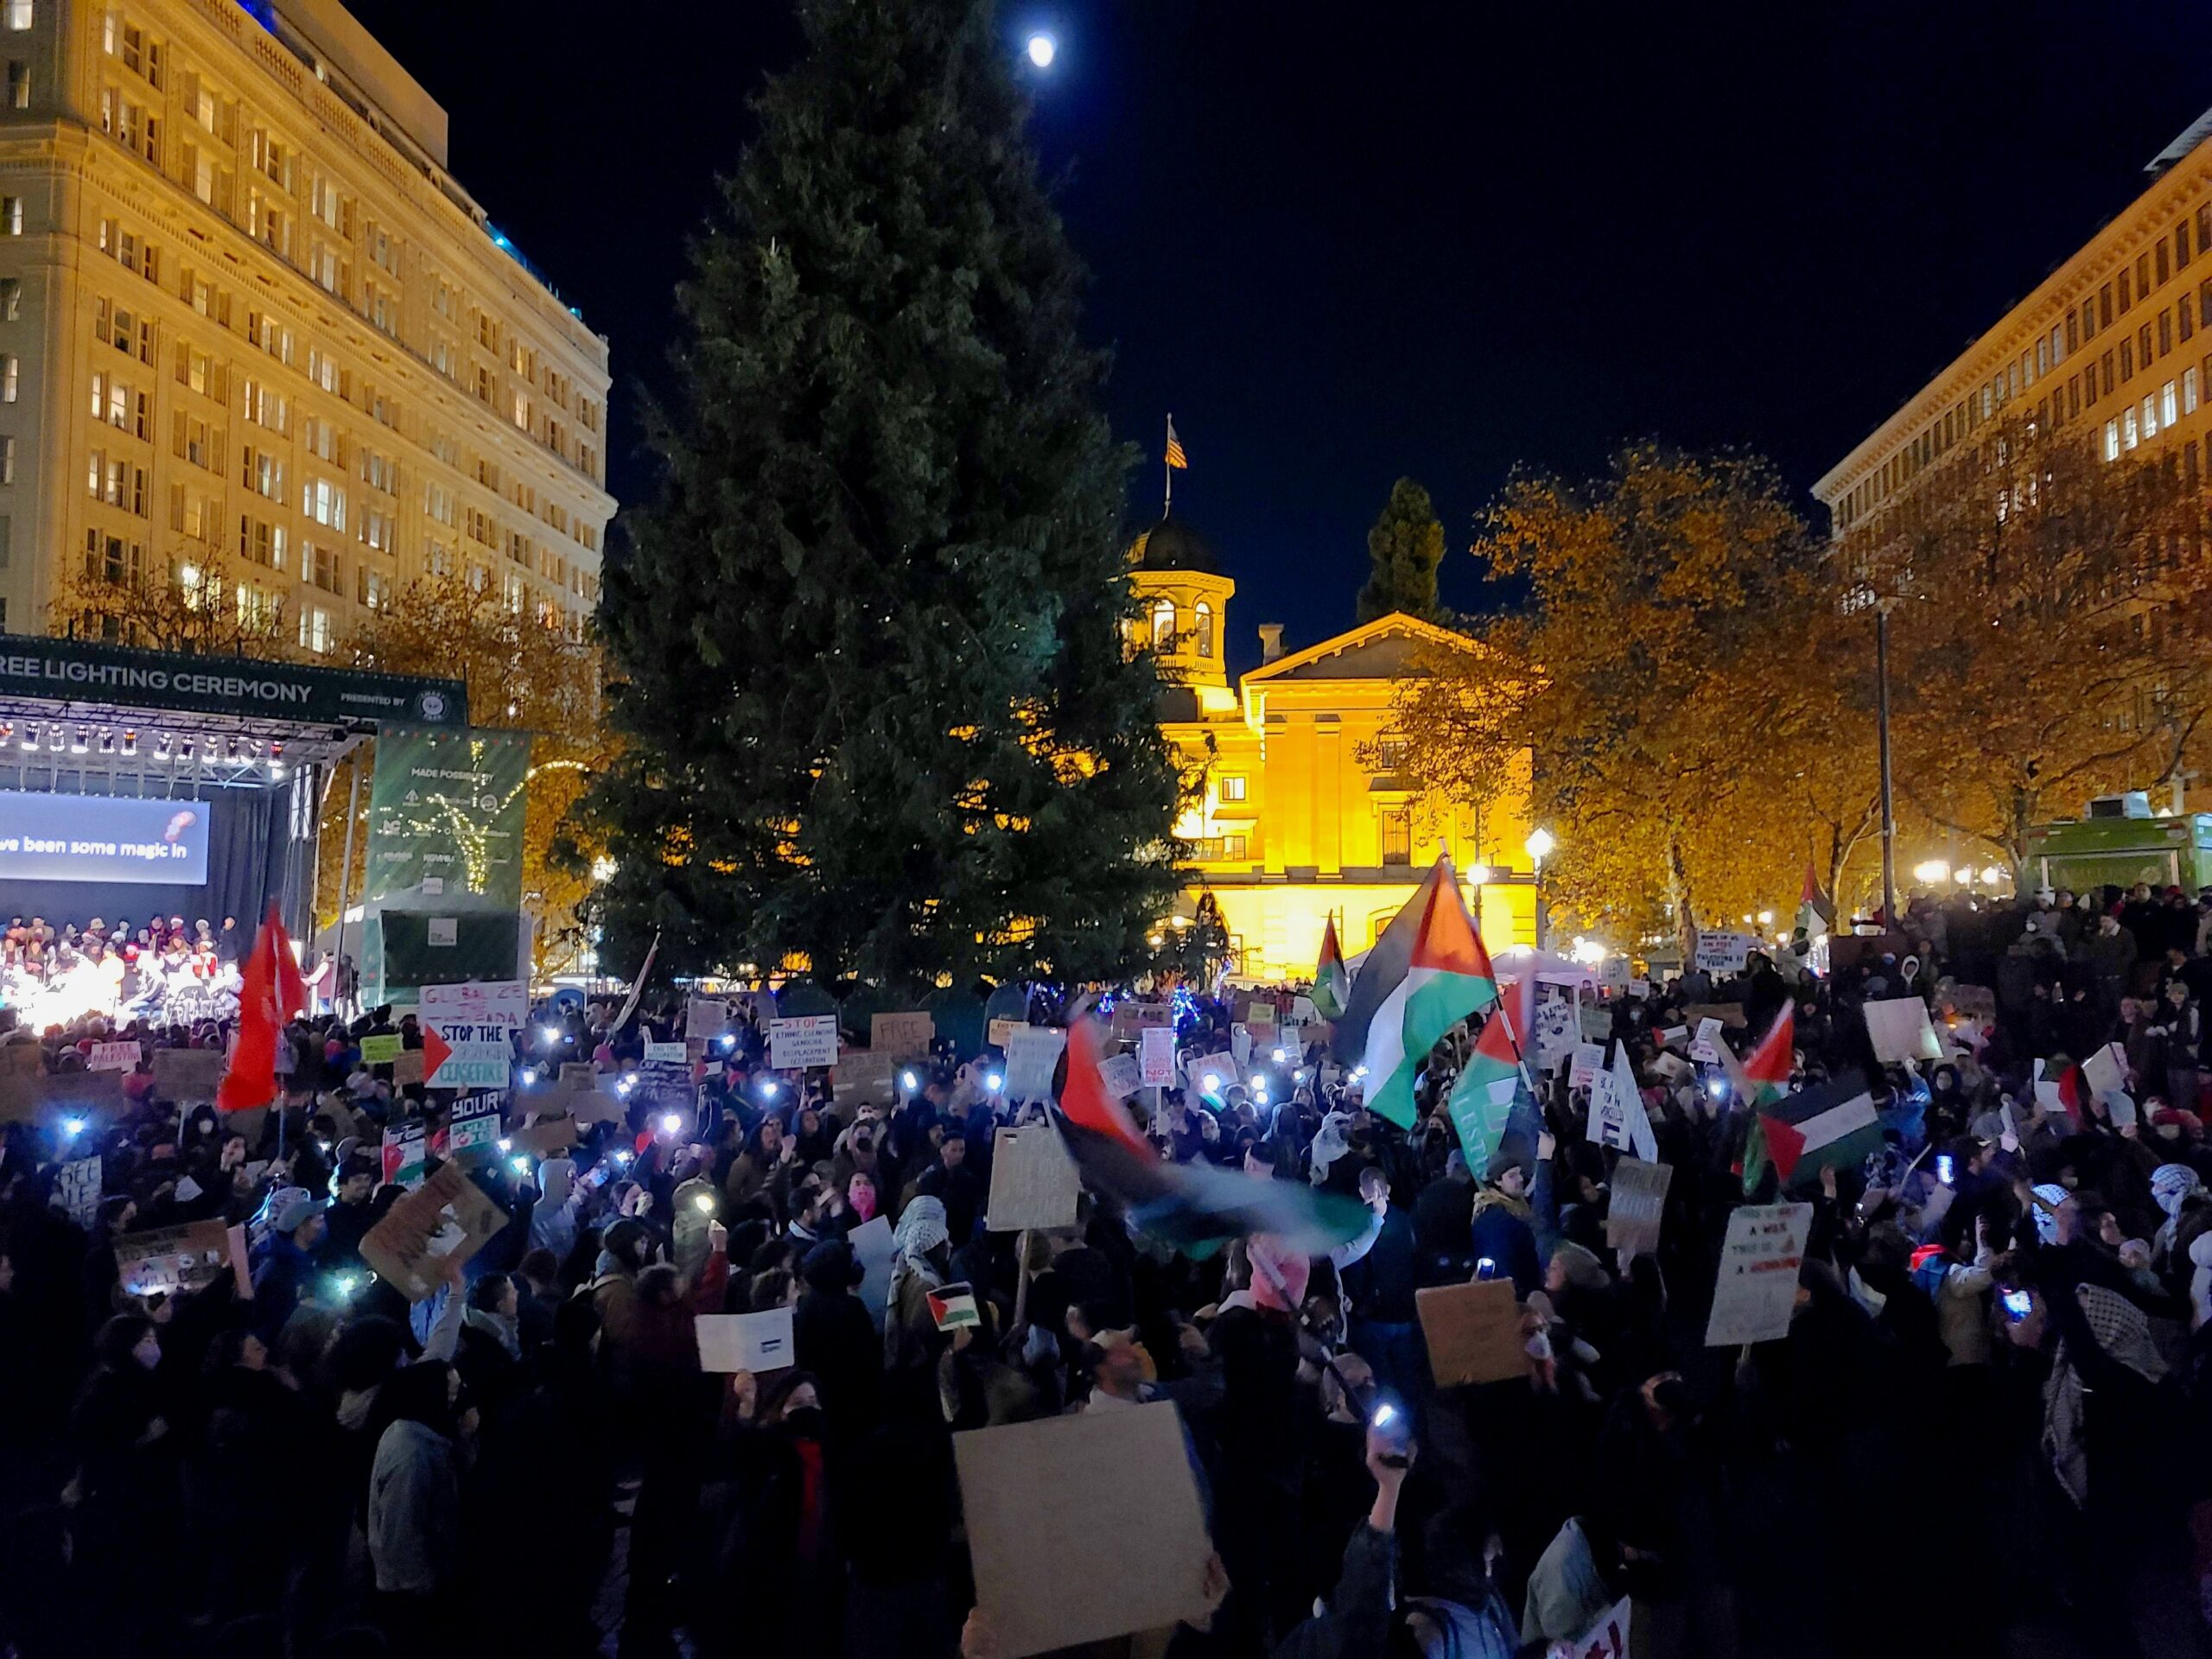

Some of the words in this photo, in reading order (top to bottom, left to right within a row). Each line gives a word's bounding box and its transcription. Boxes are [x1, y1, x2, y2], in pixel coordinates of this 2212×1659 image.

[45, 659, 168, 690] LIGHTING
[174, 673, 312, 702] CEREMONY
[340, 692, 391, 705] PRESENTED
[393, 697, 405, 706] BY
[411, 768, 437, 778] MADE
[23, 836, 67, 853] been
[71, 841, 117, 855] some
[120, 842, 168, 860] magic
[172, 843, 187, 858] in
[785, 1018, 817, 1029] STOP
[442, 1025, 473, 1041] STOP
[477, 1026, 502, 1042] THE
[880, 1020, 921, 1039] FREE
[101, 1044, 134, 1053] FREE
[783, 1047, 830, 1057] DISPLACEMENT
[93, 1053, 139, 1063] PALESTINE
[451, 1091, 499, 1120] YOUR
[1749, 1225, 1758, 1236] A
[1736, 1264, 1745, 1275] A
